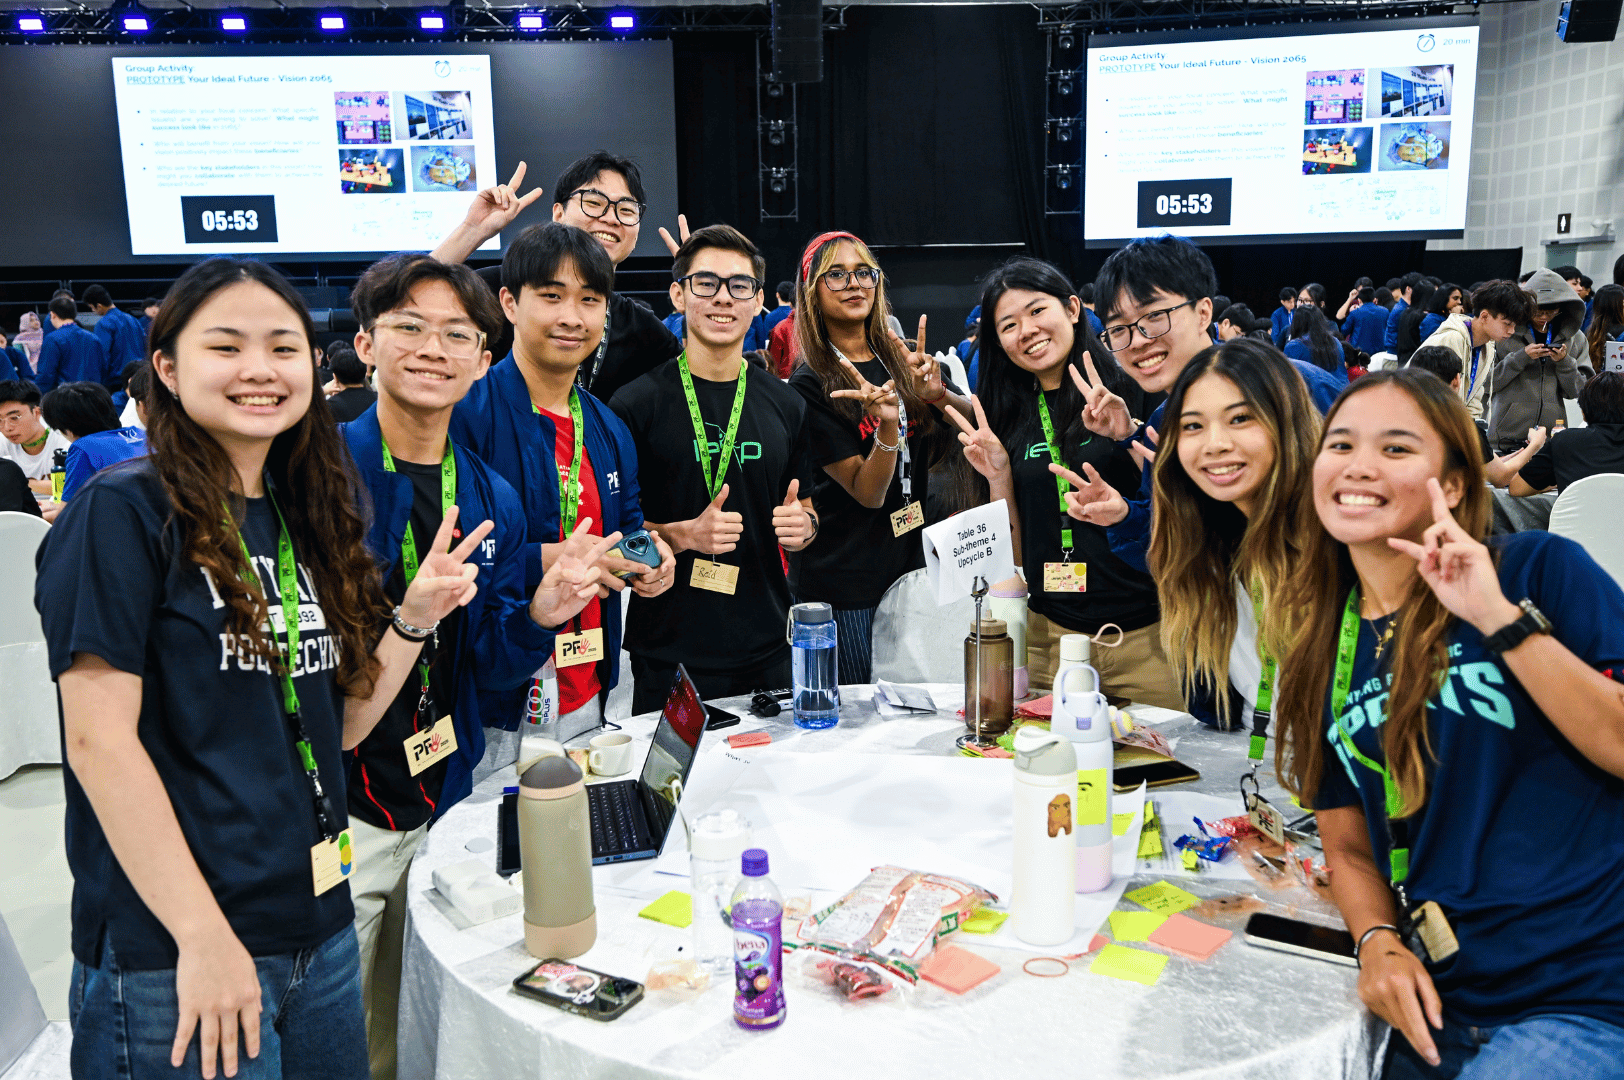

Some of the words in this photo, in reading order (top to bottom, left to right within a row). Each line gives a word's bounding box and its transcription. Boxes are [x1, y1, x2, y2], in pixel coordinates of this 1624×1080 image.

[1442, 38, 1454, 46] 20
[1098, 53, 1128, 62] Group
[1130, 51, 1168, 61] Activity:
[1098, 63, 1156, 74] PROTOTYPE
[1158, 61, 1180, 70] Your
[1182, 60, 1208, 68] Ideal
[1209, 58, 1241, 67] Future
[1250, 56, 1280, 65] Vision
[1282, 54, 1307, 64] 2065
[125, 64, 155, 74] Group
[157, 63, 196, 74] Activity:
[126, 75, 186, 85] PROTOTYPE
[187, 75, 209, 83] Your
[211, 74, 236, 83] Ideal
[238, 74, 270, 83] Future
[277, 74, 308, 83] Vision
[309, 74, 333, 84] 2065
[1242, 97, 1263, 105] What
[1266, 96, 1288, 104] might
[1156, 193, 1213, 216] 05:53
[202, 209, 259, 232] 05:53
[957, 527, 975, 542] Table
[976, 523, 987, 535] 36
[953, 537, 990, 558] Sub-theme
[991, 532, 996, 542] 4
[957, 550, 985, 569] Upcycle
[986, 546, 993, 557] B
[543, 697, 551, 718] PLUS
